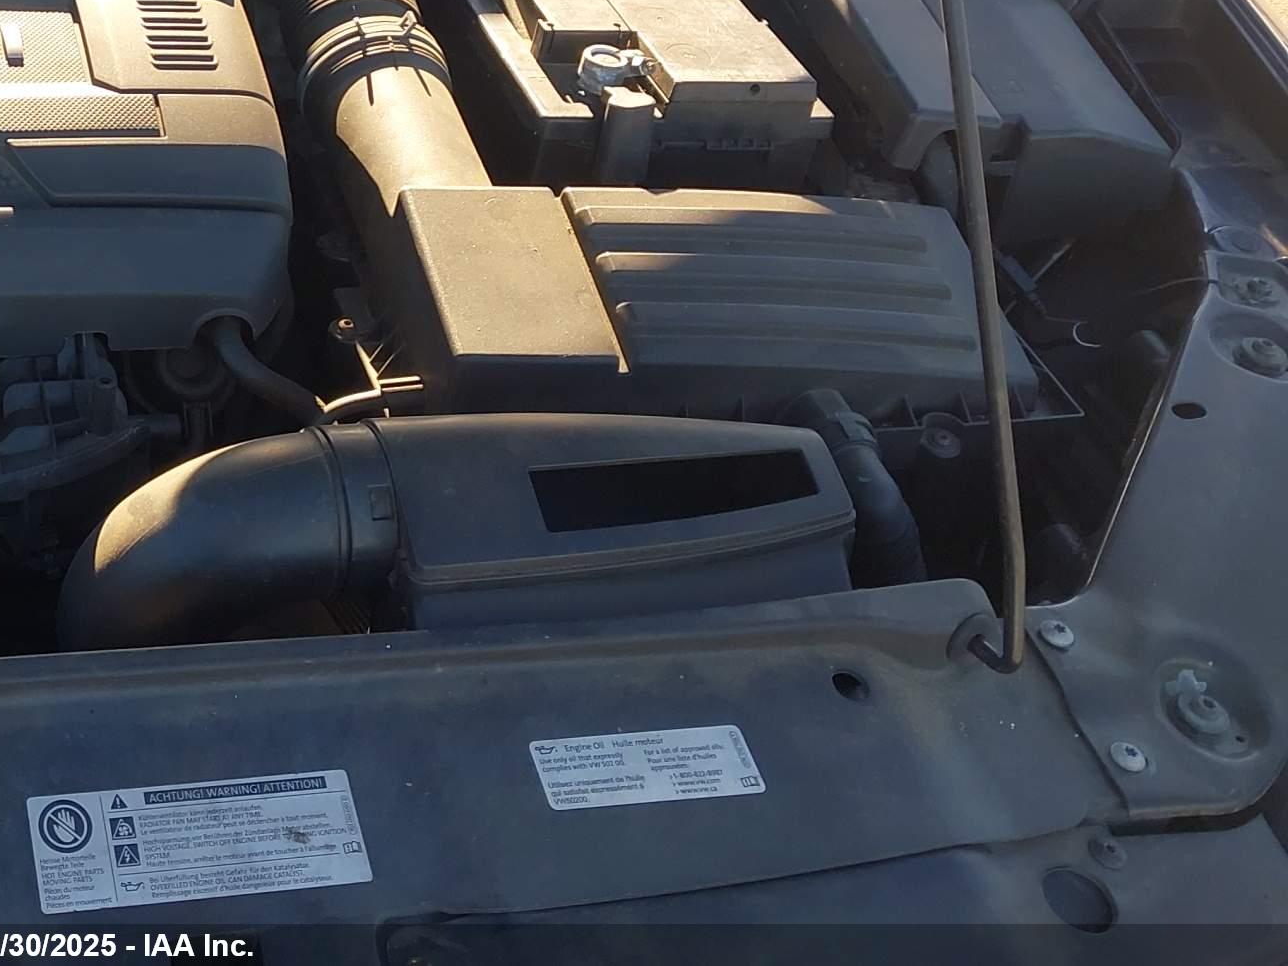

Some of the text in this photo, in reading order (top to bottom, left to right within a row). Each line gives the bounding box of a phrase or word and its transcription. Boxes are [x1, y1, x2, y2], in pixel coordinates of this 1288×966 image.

[564, 742, 605, 753] Engine Oil
[611, 737, 663, 748] Huile moteur
[148, 779, 324, 803] ACHTUNG! WARNING! ATTENTION!
